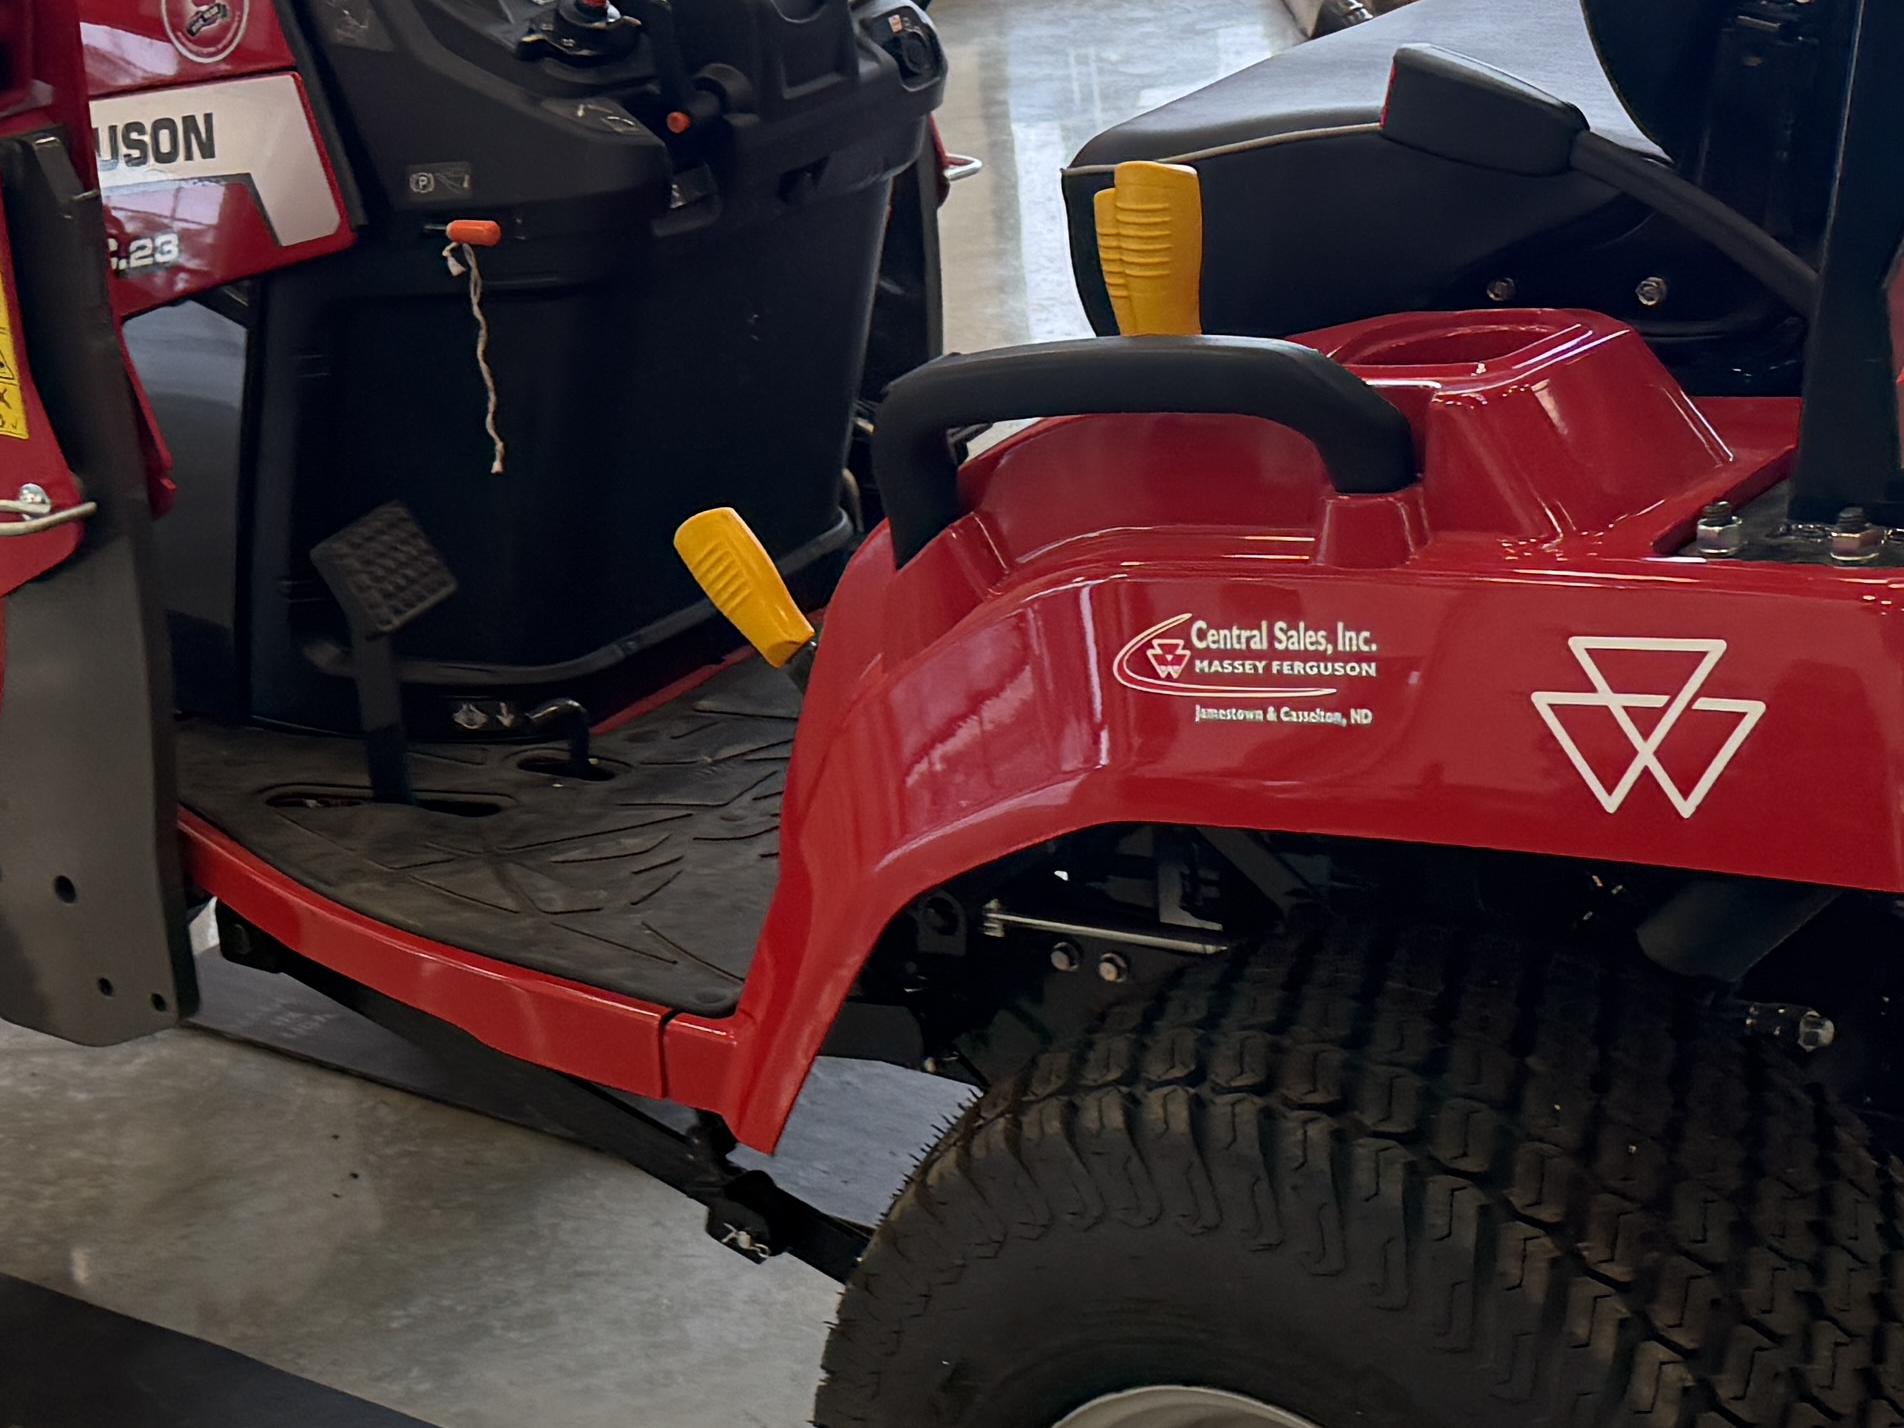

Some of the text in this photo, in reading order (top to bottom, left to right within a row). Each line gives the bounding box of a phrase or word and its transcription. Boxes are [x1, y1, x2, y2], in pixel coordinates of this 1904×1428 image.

[1191, 619, 1378, 655] Central Sales, Inc.
[1194, 659, 1377, 677] MASSEY FERGUSON
[1194, 704, 1264, 722] Jamestown
[1266, 706, 1278, 722] &
[1350, 708, 1373, 725] ND
